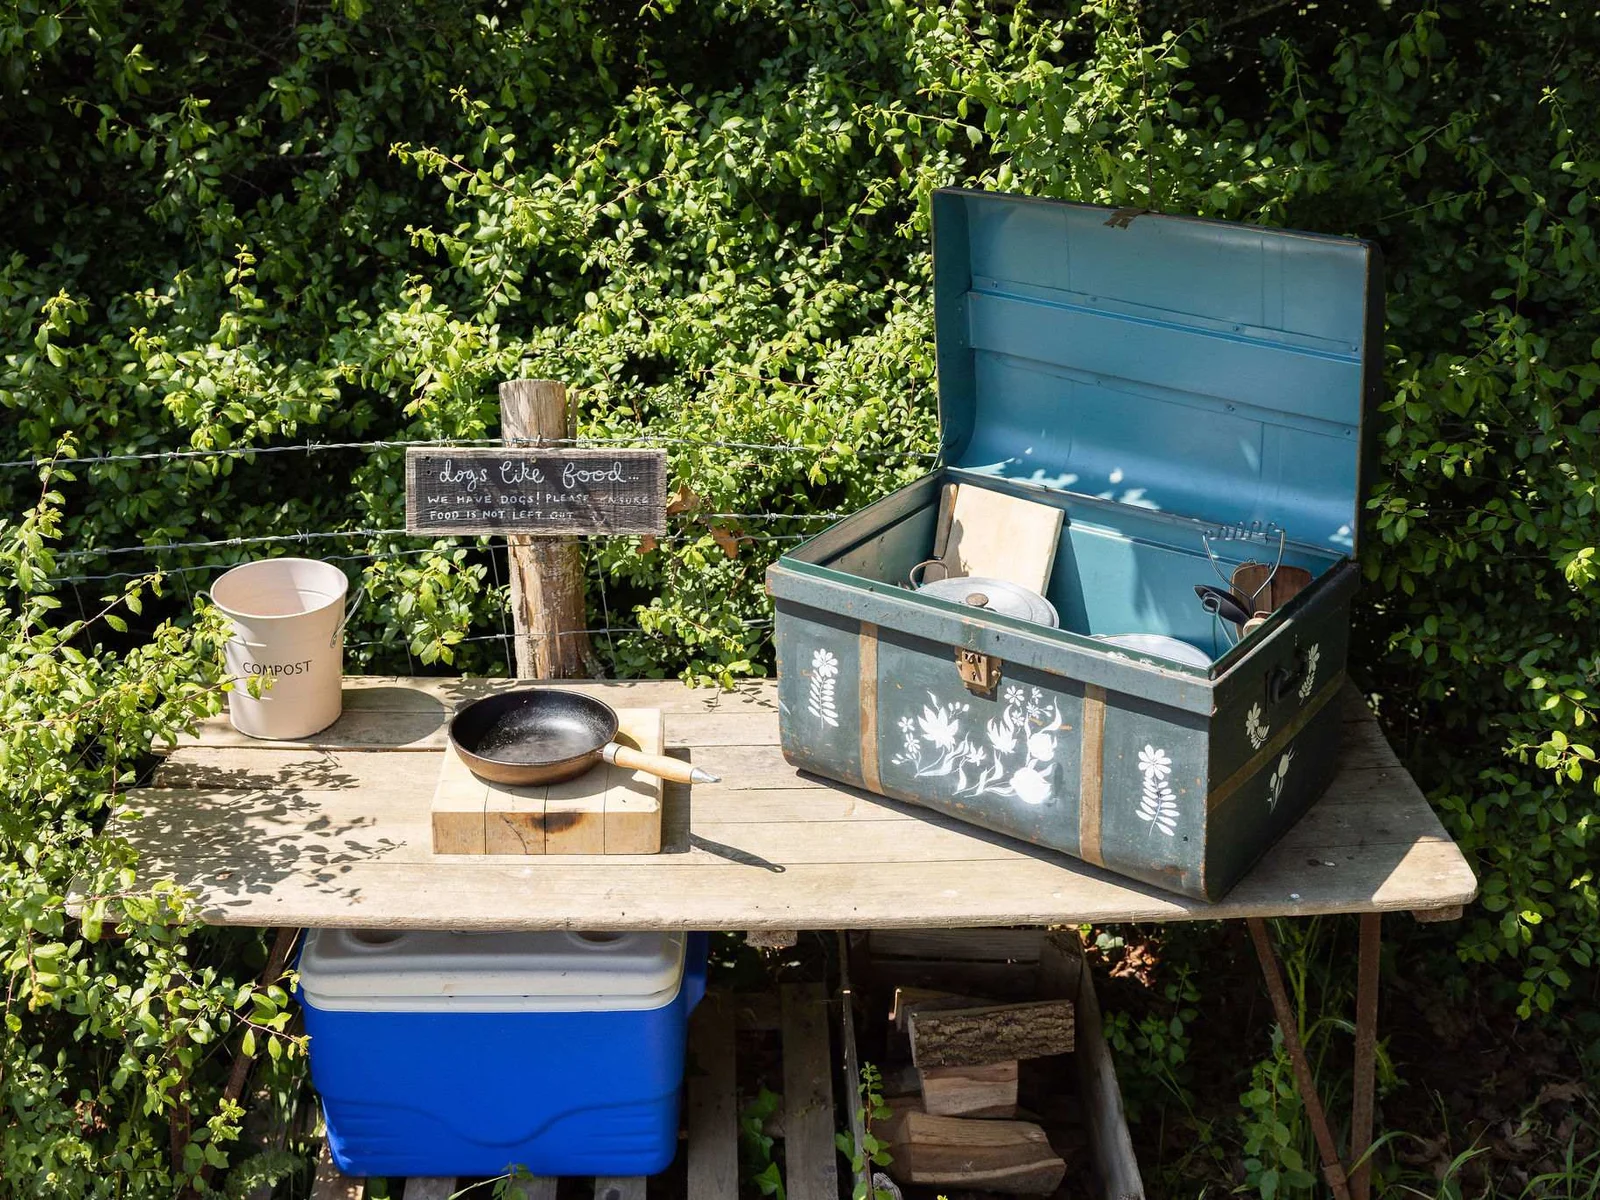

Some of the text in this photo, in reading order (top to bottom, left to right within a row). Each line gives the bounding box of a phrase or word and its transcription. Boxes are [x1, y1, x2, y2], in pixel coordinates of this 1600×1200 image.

[439, 459, 488, 492] dogs
[499, 460, 544, 485] like
[427, 495, 448, 504] WE
[456, 494, 492, 504] HAVE
[501, 491, 540, 505] DOGS!
[545, 493, 590, 504] PLEASE
[429, 510, 459, 520] FOOD
[466, 510, 477, 519] IS
[482, 510, 506, 520] NOT
[512, 509, 542, 520] LEFT
[242, 659, 313, 676] COMPOST
